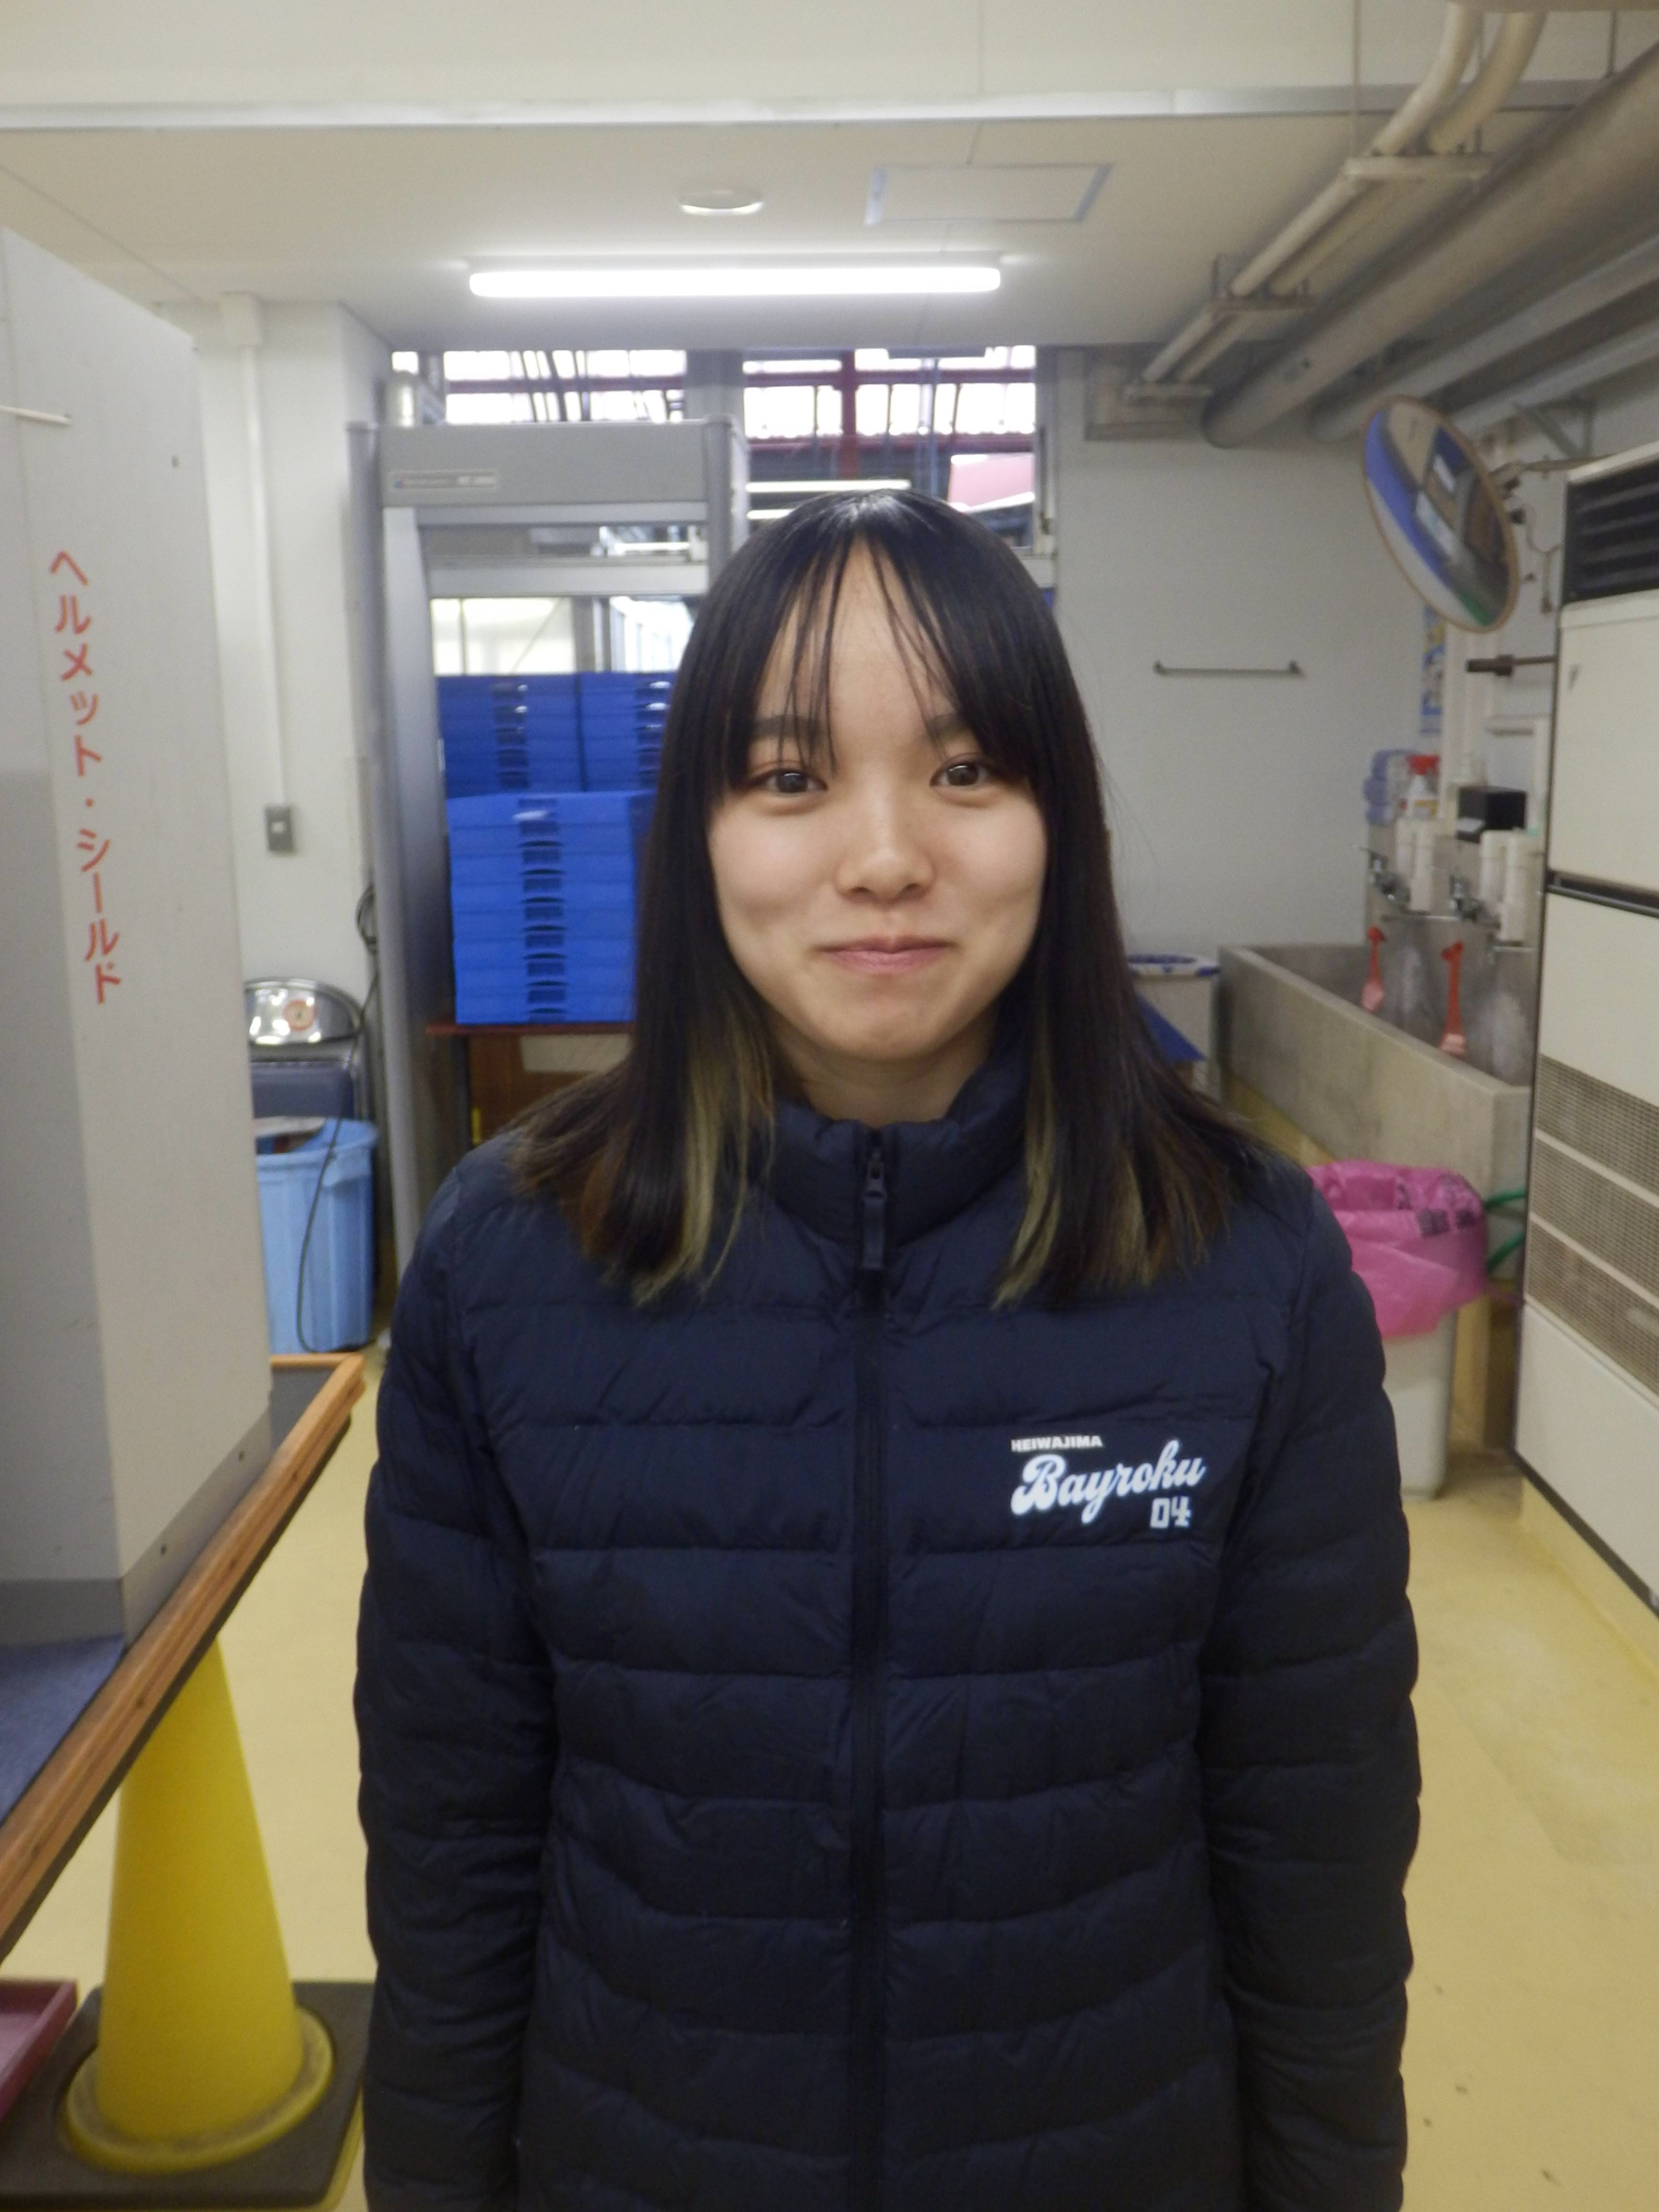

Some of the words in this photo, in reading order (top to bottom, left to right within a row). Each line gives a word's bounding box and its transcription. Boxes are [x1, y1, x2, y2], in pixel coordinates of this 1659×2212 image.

[1010, 1435, 1104, 1453] HEIWAJIMA
[1010, 1439, 1206, 1525] Bayroku
[1150, 1496, 1191, 1528] 04
